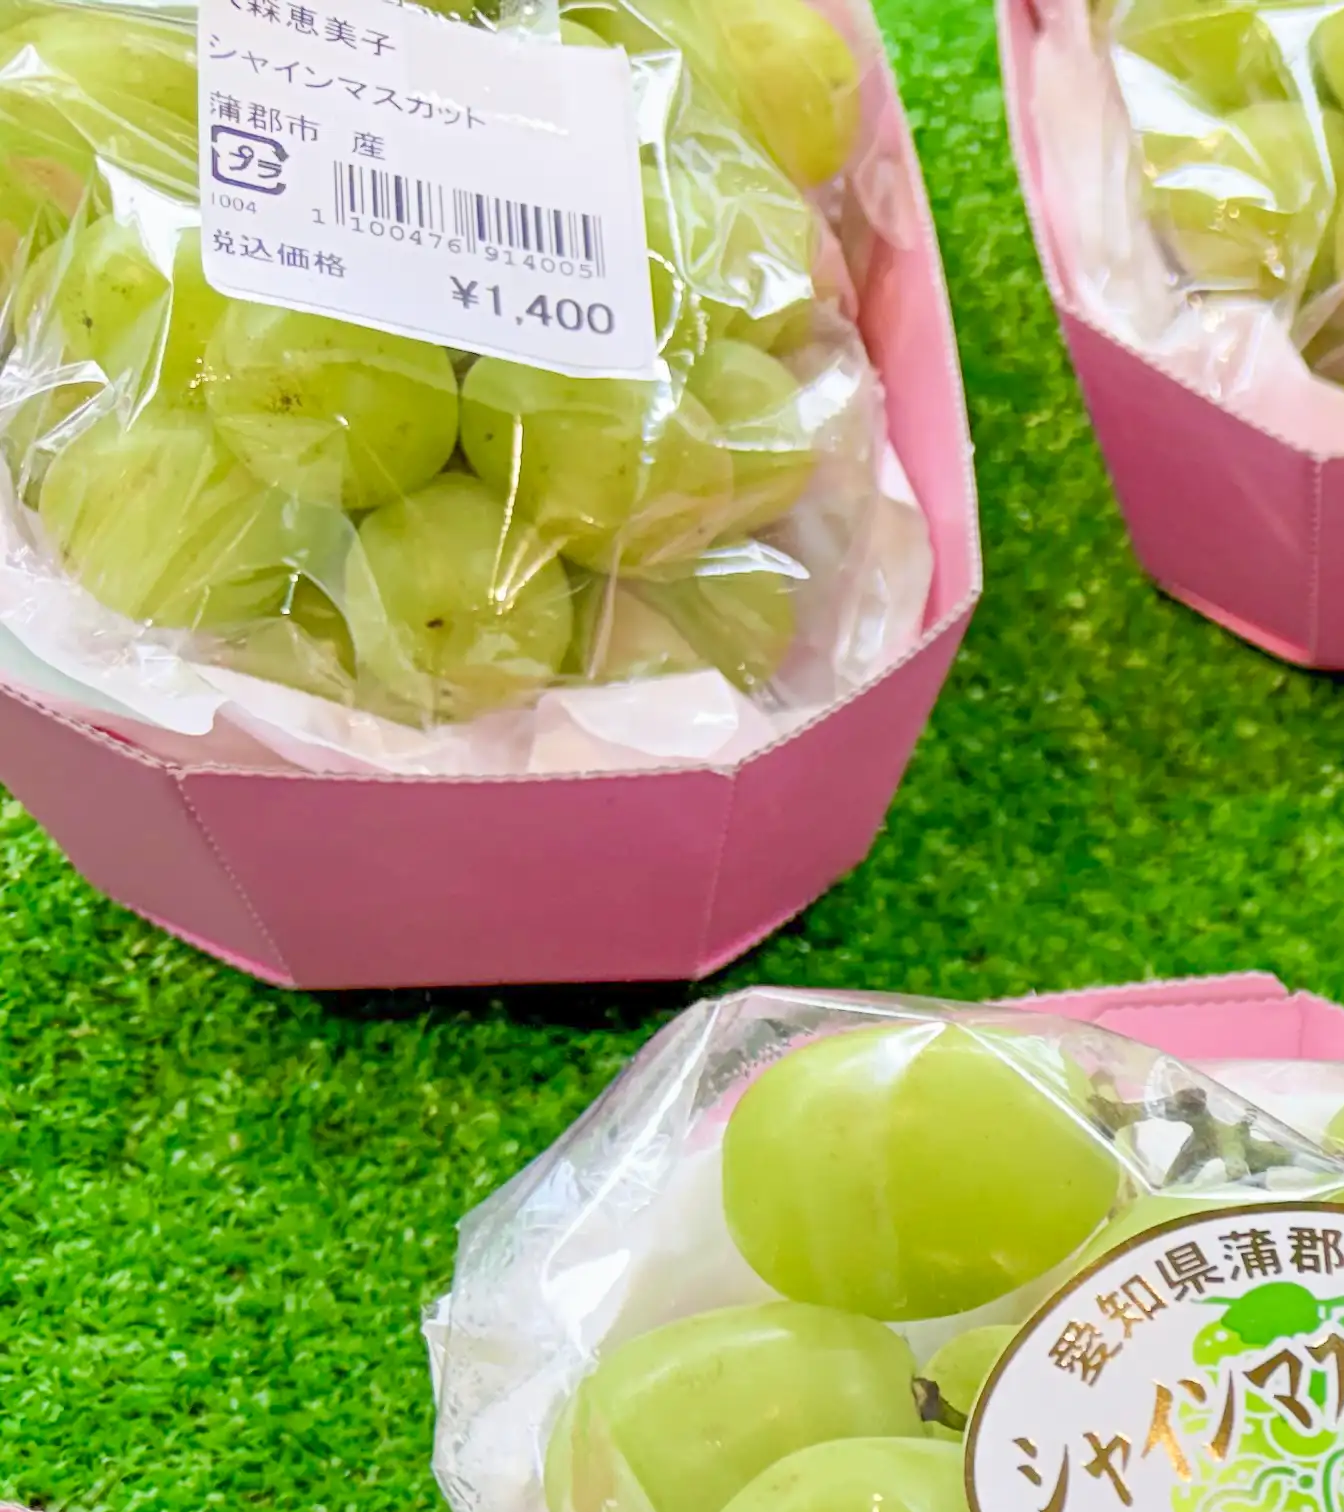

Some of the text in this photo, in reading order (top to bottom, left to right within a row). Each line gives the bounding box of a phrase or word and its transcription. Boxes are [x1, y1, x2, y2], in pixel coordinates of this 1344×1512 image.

[231, 0, 396, 56] 森恵美子
[208, 34, 487, 130] シャインマスカット
[209, 91, 387, 161] 蒲郡市 産
[211, 191, 258, 215] 1004
[312, 207, 594, 280] 1 100476 914005
[448, 275, 616, 336] ¥1,400
